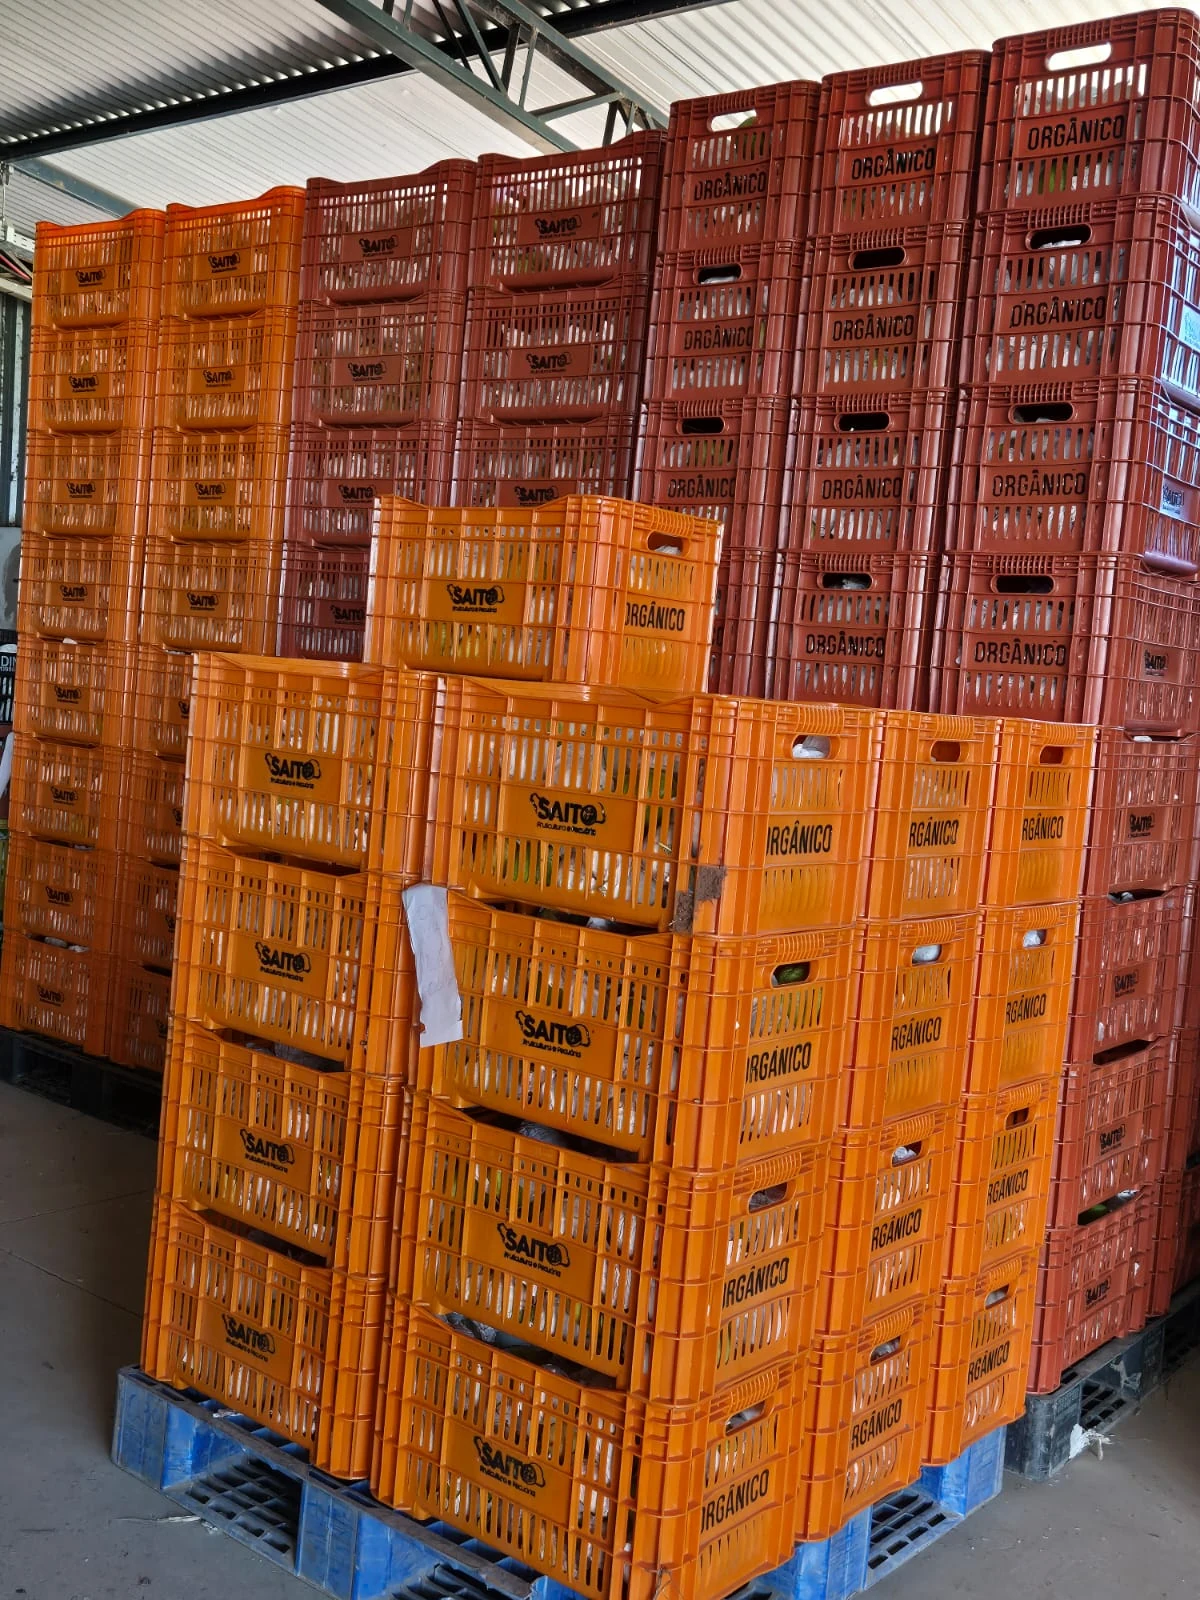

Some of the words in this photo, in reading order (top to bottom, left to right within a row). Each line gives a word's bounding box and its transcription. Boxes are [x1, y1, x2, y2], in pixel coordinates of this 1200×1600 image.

[1028, 114, 1125, 150] ORGÂNICO
[852, 147, 935, 180] ORGÂNICO
[694, 170, 767, 200] ORGÂNICO
[539, 219, 577, 234] SAITO
[363, 238, 396, 253] SAITO
[1010, 296, 1105, 328] ORGÂNICO
[684, 323, 754, 350] ORGÂNICO
[833, 312, 914, 341] ORGÂNICO
[351, 363, 383, 378] SAITO
[530, 354, 567, 369] SAITO
[342, 486, 374, 499] SAITO
[518, 487, 554, 500] SAITO
[668, 474, 735, 499] ORGÂNICO
[822, 472, 902, 500] ORGÂNICO
[993, 470, 1086, 497] ORGÂNICO
[452, 585, 498, 606] SAITO
[334, 607, 364, 620] SAITO
[806, 630, 885, 658] ORGÂNICO
[975, 637, 1066, 666] ORGÂNICO
[271, 757, 315, 780] SAITO
[538, 800, 597, 825] SAITO
[261, 947, 305, 973] SAITO
[523, 1017, 582, 1046] SAITO
[246, 1133, 288, 1163] SAITO
[505, 1228, 562, 1266] SAITO
[227, 1316, 270, 1353] SAITO
[480, 1441, 536, 1486] SAITO
